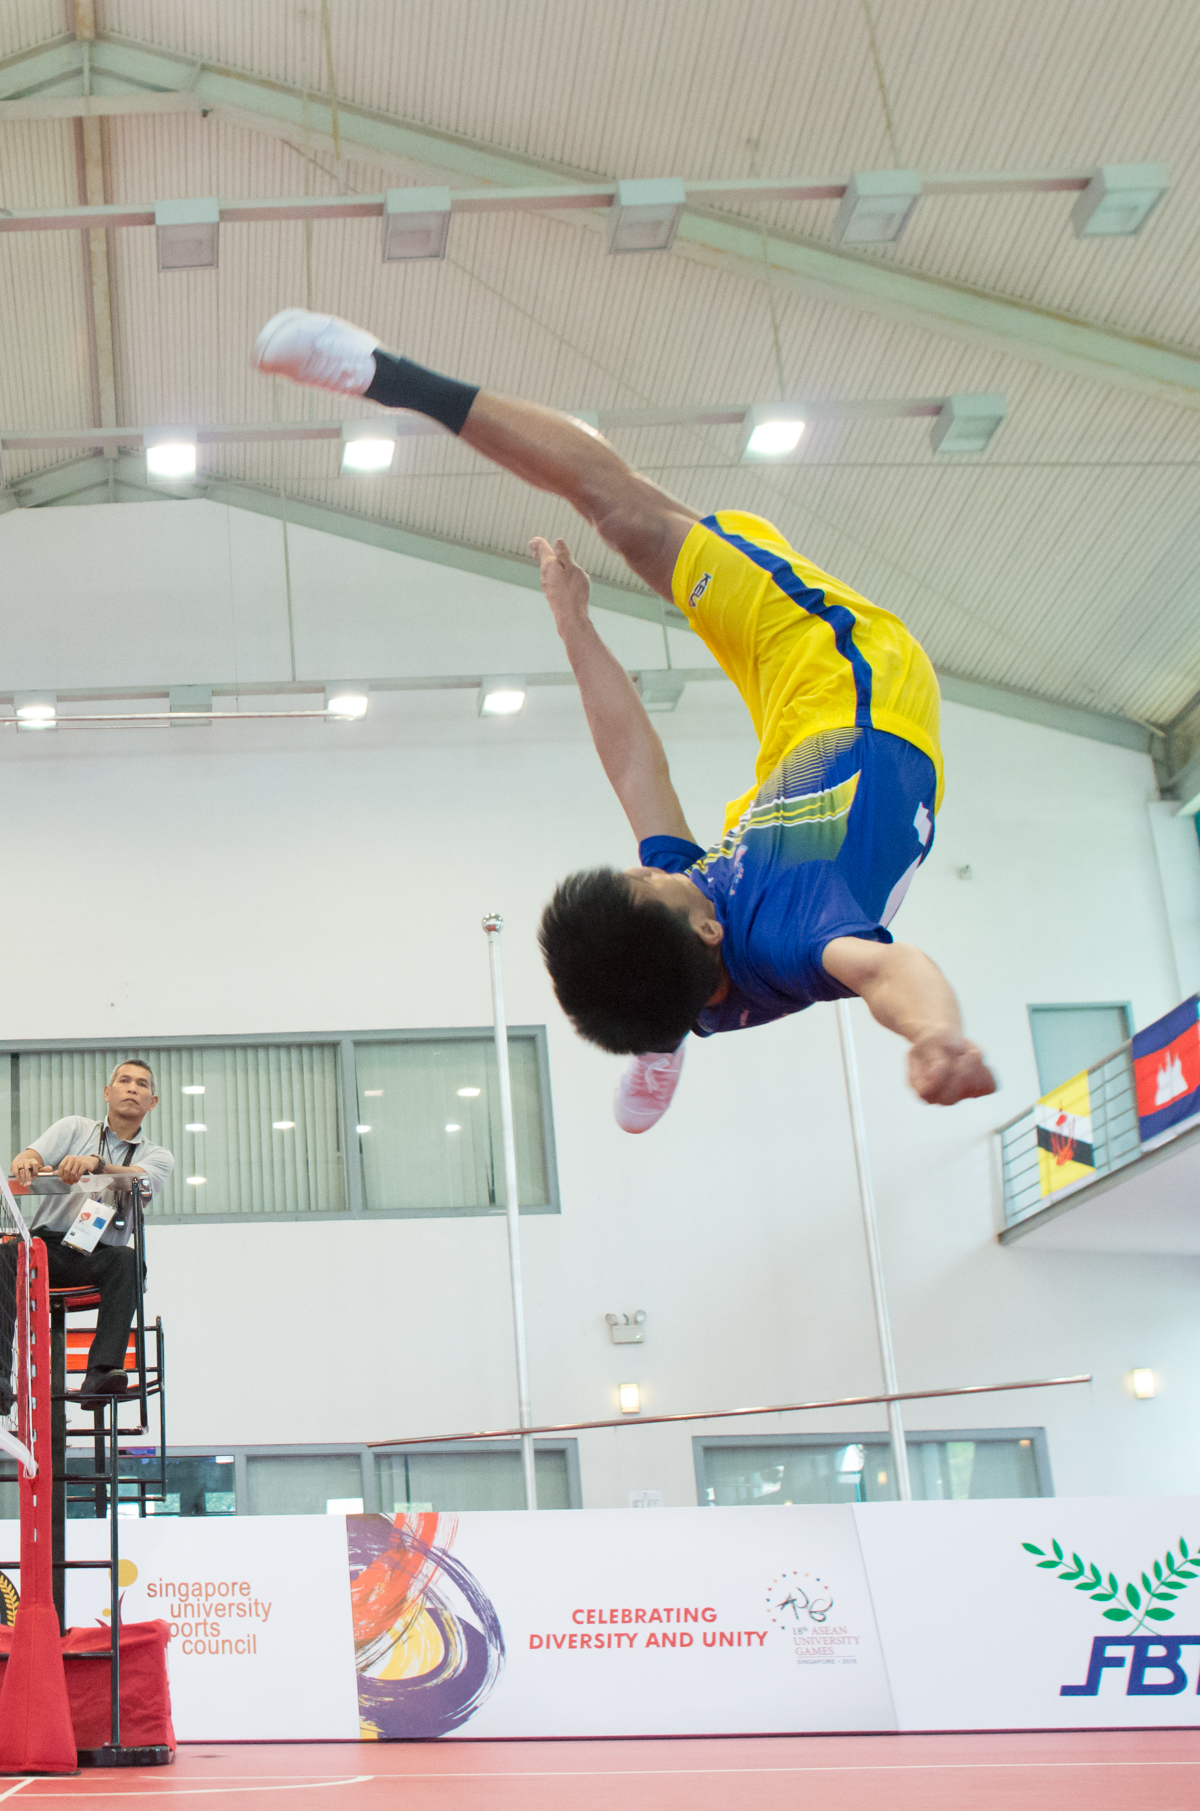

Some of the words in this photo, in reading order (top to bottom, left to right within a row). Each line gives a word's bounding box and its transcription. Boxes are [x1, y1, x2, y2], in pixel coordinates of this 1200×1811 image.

[146, 1578, 251, 1602] singapore
[170, 1597, 272, 1622] university
[571, 1607, 718, 1625] CELEBRATING
[811, 1626, 847, 1635] ASEAN
[182, 1634, 257, 1655] council
[529, 1633, 639, 1650] DIVERSITY
[645, 1632, 694, 1648] AND
[702, 1631, 769, 1648] UNITY
[793, 1636, 860, 1645] UNIVERSITY
[795, 1646, 835, 1656] GAMES
